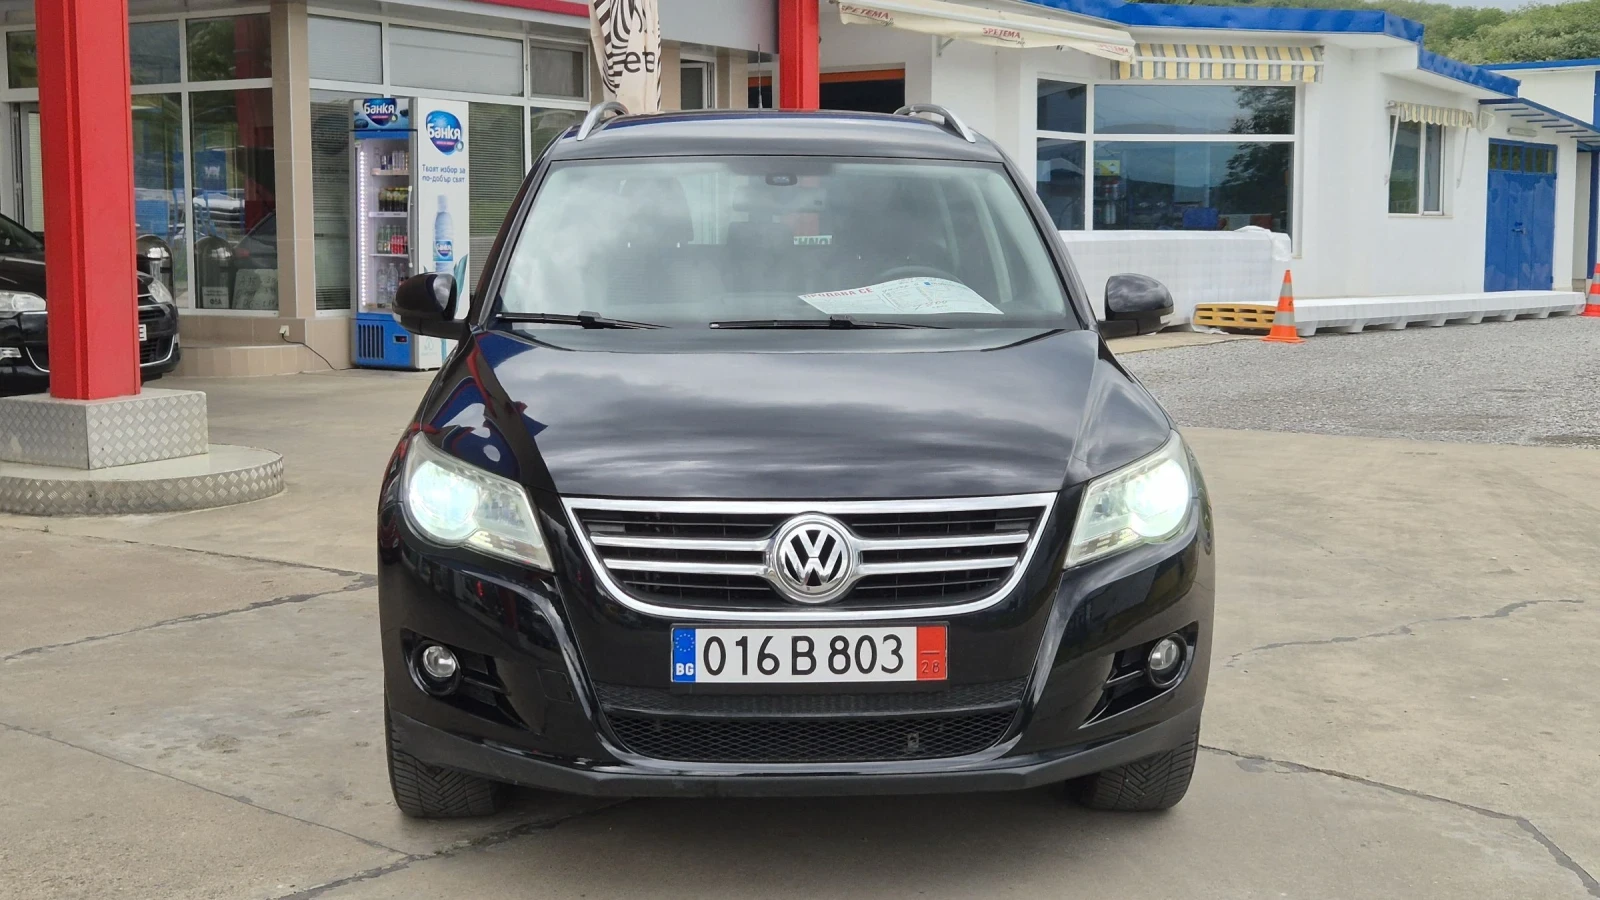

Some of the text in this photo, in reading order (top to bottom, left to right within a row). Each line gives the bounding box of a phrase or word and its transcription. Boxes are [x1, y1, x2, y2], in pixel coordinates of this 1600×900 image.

[982, 27, 1021, 39] SPETEMA
[422, 164, 439, 173] Твоят
[440, 166, 458, 175] избор
[780, 526, 848, 591] VW
[675, 662, 695, 676] BG
[920, 659, 941, 675] 28
